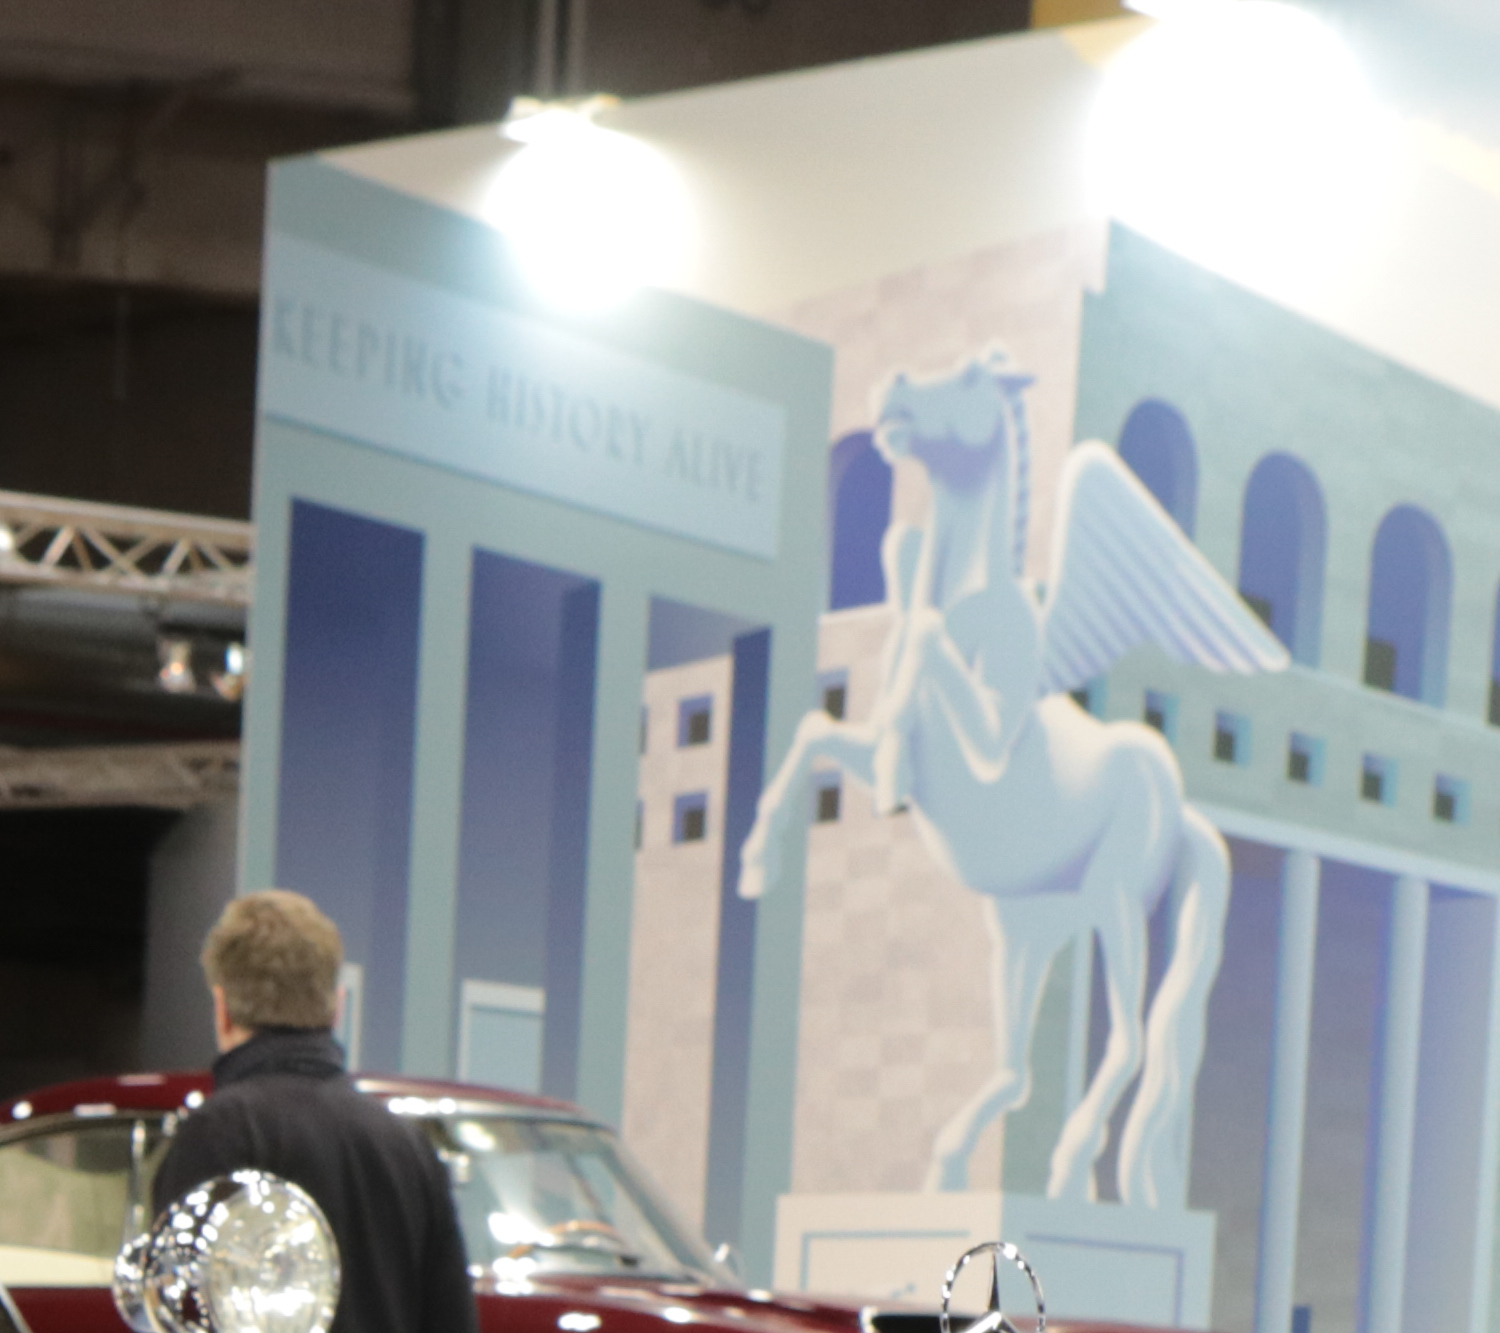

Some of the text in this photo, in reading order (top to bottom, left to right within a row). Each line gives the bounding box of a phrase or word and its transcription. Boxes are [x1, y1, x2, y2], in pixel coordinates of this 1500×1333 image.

[271, 302, 767, 502] KEEPING HISTORY ALIVE
